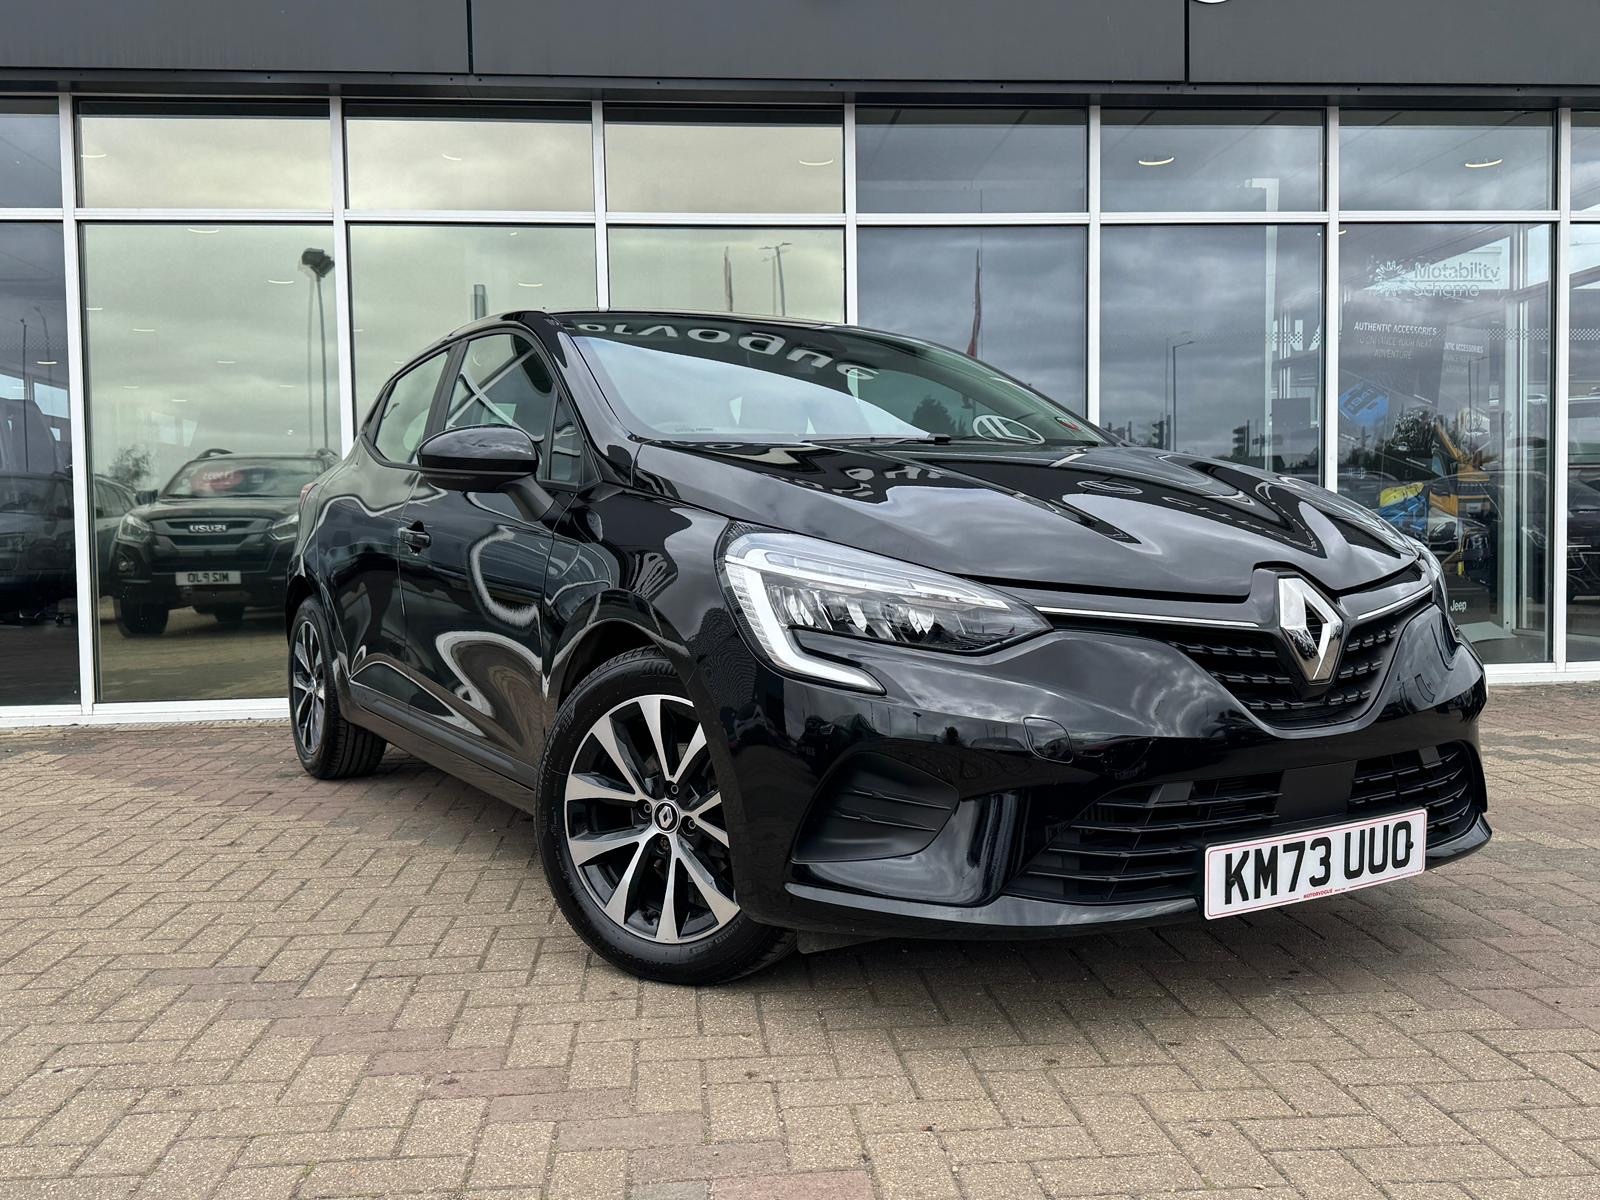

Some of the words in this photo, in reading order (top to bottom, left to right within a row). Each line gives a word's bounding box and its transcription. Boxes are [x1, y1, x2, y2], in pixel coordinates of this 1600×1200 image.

[1414, 261, 1500, 283] Motability
[1354, 321, 1392, 333] AUTHENTIC
[1393, 324, 1437, 336] ACCESSORIES
[1450, 600, 1467, 612] Jeep
[1224, 837, 1332, 905] KM73
[1344, 820, 1413, 880] UUO
